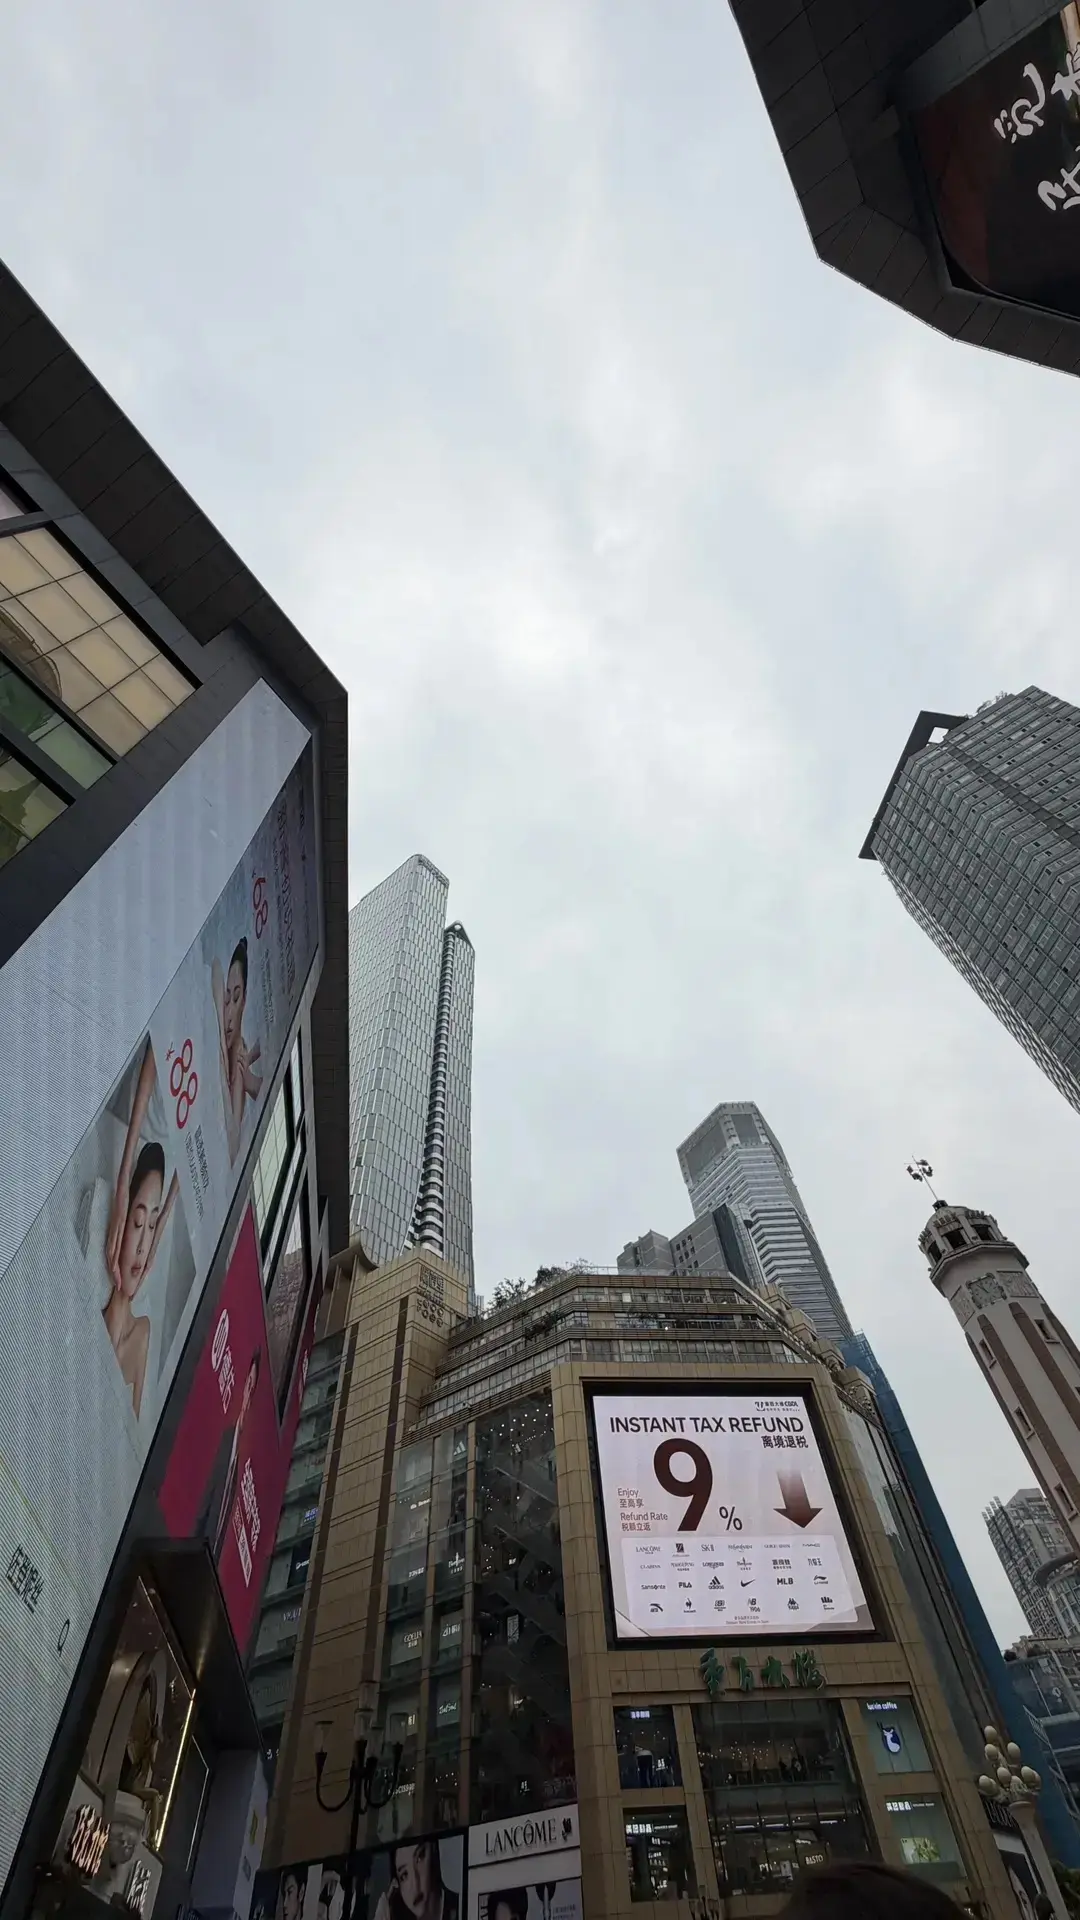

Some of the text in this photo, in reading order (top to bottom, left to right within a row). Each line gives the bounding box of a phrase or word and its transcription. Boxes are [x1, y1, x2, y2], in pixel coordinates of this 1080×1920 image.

[610, 1416, 804, 1433] INSTANT TAX REFUND
[761, 1434, 809, 1449] 离境退税
[617, 1487, 640, 1499] Enjoy
[619, 1498, 645, 1509] 至高享
[620, 1511, 669, 1521] Refund Rate
[776, 1577, 794, 1586] MLB
[485, 1818, 557, 1856] LANCÔME
